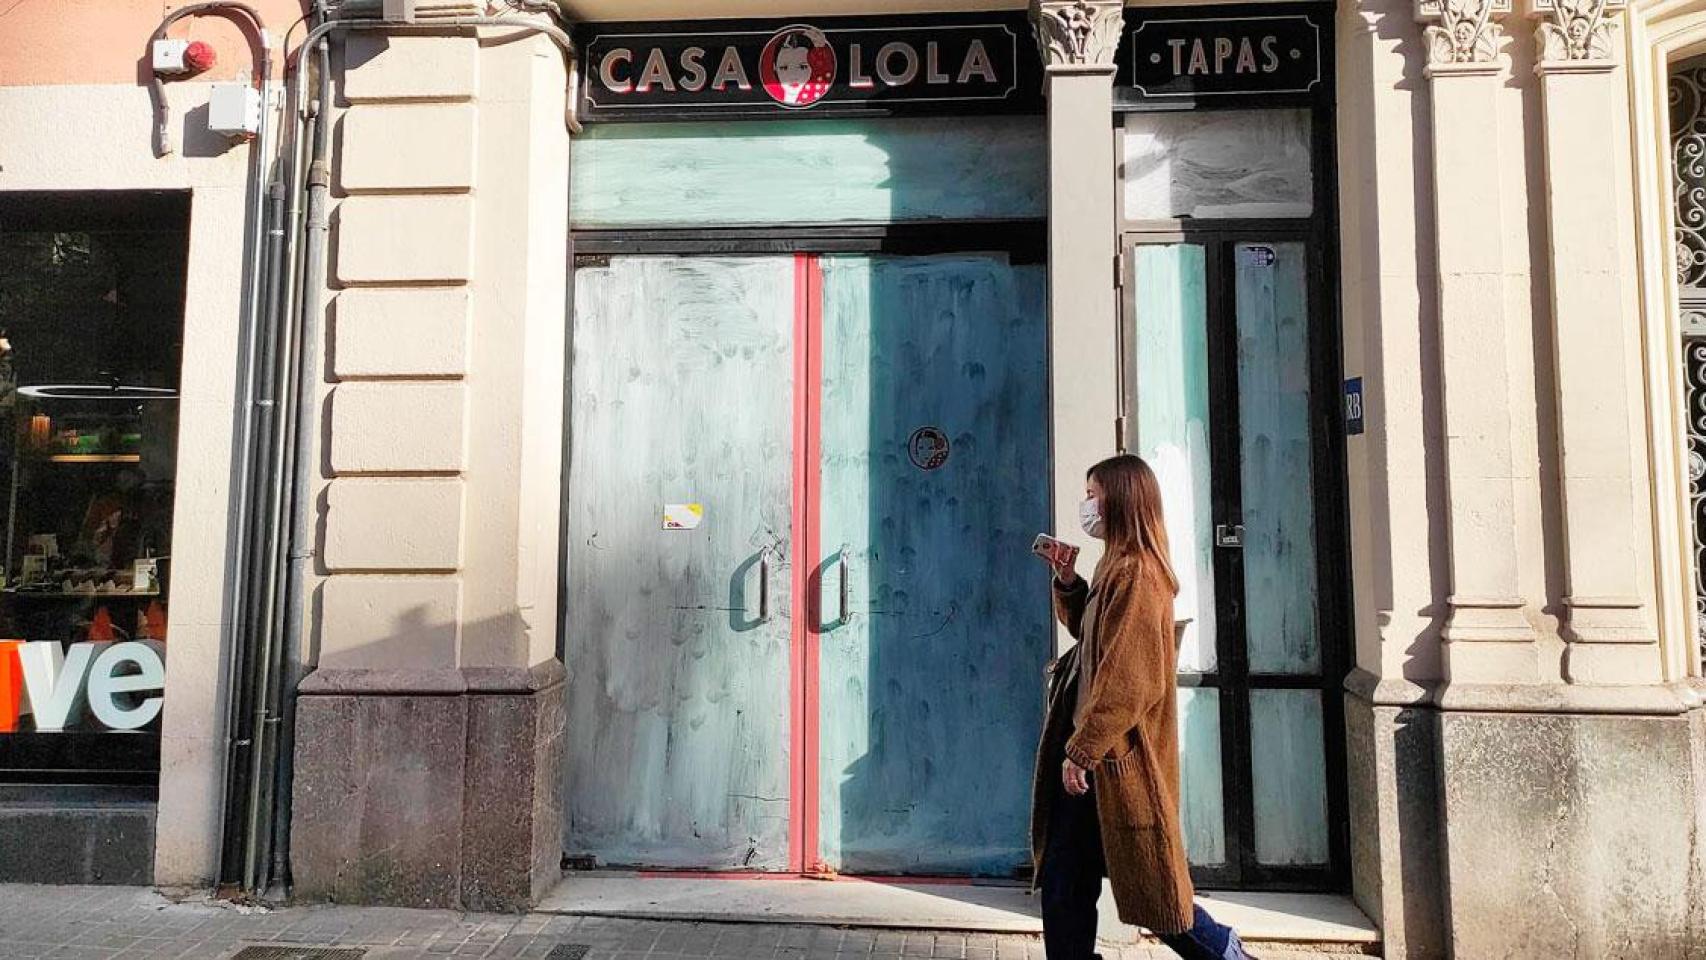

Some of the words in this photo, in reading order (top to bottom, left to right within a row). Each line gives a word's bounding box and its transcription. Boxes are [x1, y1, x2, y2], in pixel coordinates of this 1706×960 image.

[600, 46, 752, 92] CASA
[849, 38, 998, 87] LOLA
[1167, 35, 1279, 75] TAPAS
